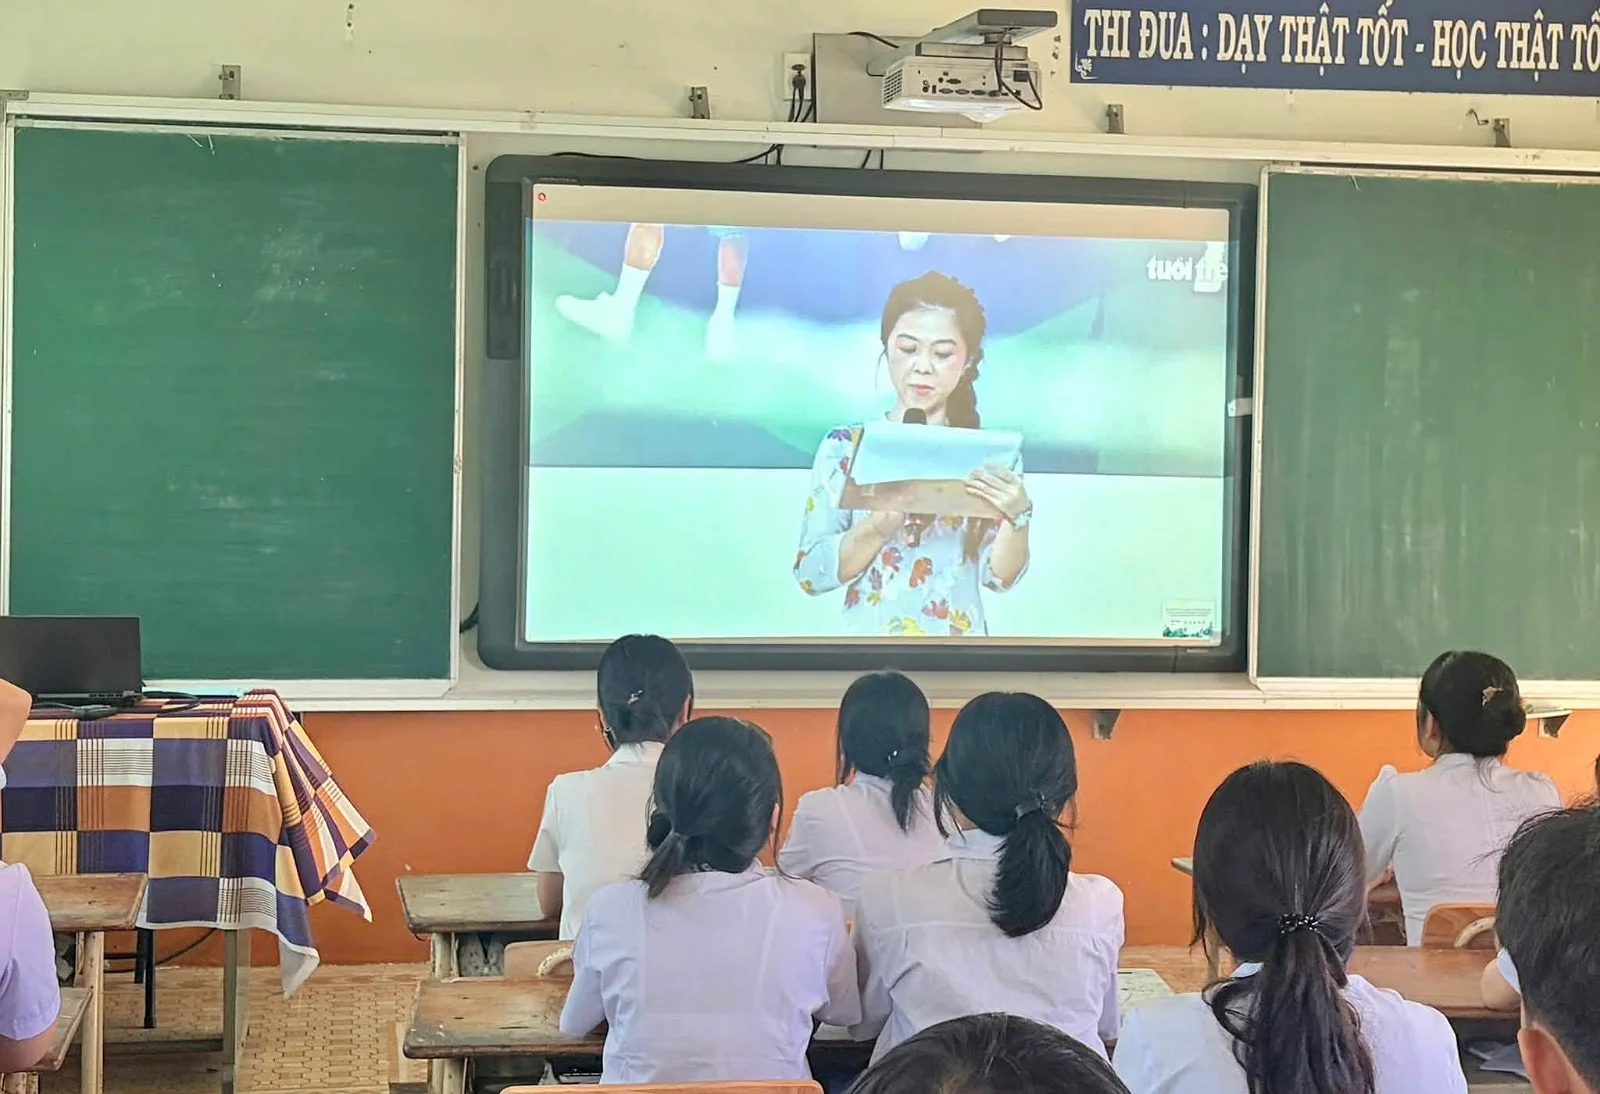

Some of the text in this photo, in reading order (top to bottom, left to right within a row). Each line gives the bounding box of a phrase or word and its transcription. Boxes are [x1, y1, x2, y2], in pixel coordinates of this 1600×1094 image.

[1084, 9, 1131, 58] THI
[1138, 10, 1194, 60] ĐUA
[1202, 23, 1208, 61] :
[1216, 13, 1273, 74] DẠY
[1279, 2, 1350, 76] THẬT
[1356, 0, 1408, 67] TỐT
[1431, 19, 1487, 80] HỌC
[1494, 8, 1564, 82] THẬT
